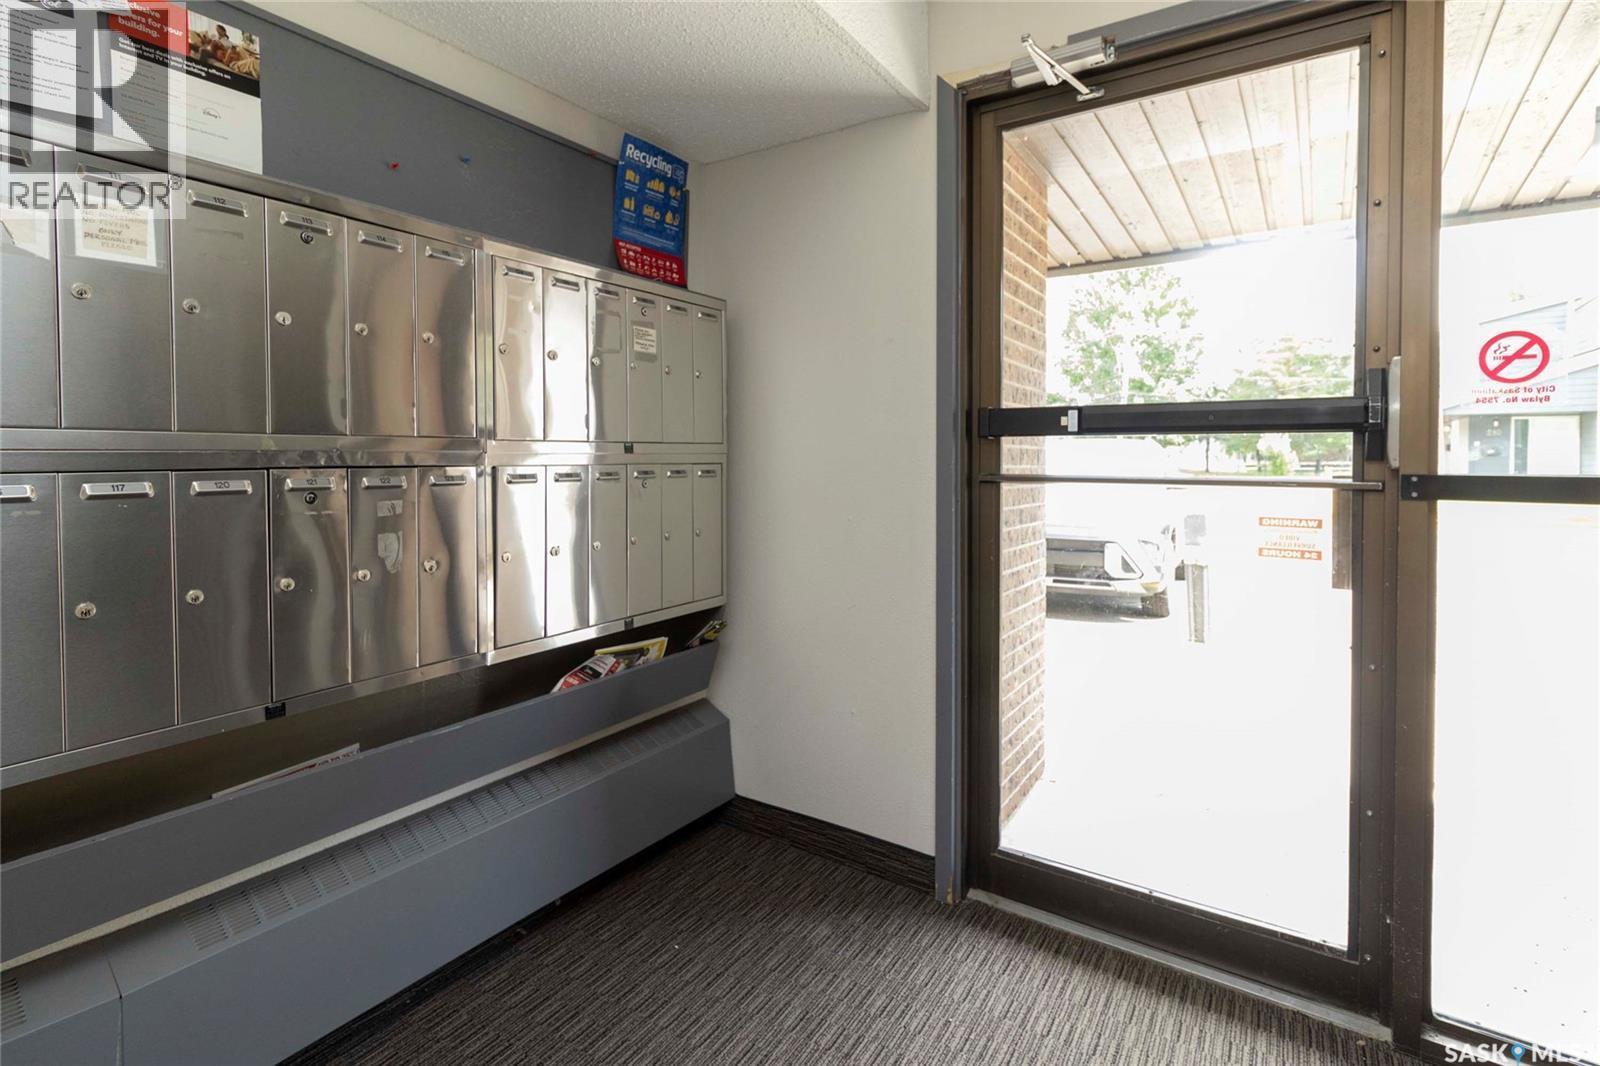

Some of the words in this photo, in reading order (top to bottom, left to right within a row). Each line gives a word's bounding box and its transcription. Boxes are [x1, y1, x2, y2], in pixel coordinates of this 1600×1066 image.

[117, 17, 161, 38] building.
[148, 17, 161, 29] for
[162, 24, 184, 37] your
[625, 143, 673, 178] Recycling
[212, 195, 226, 205] 112
[214, 481, 230, 489] 120
[306, 478, 318, 486] 121
[111, 484, 125, 492] 117
